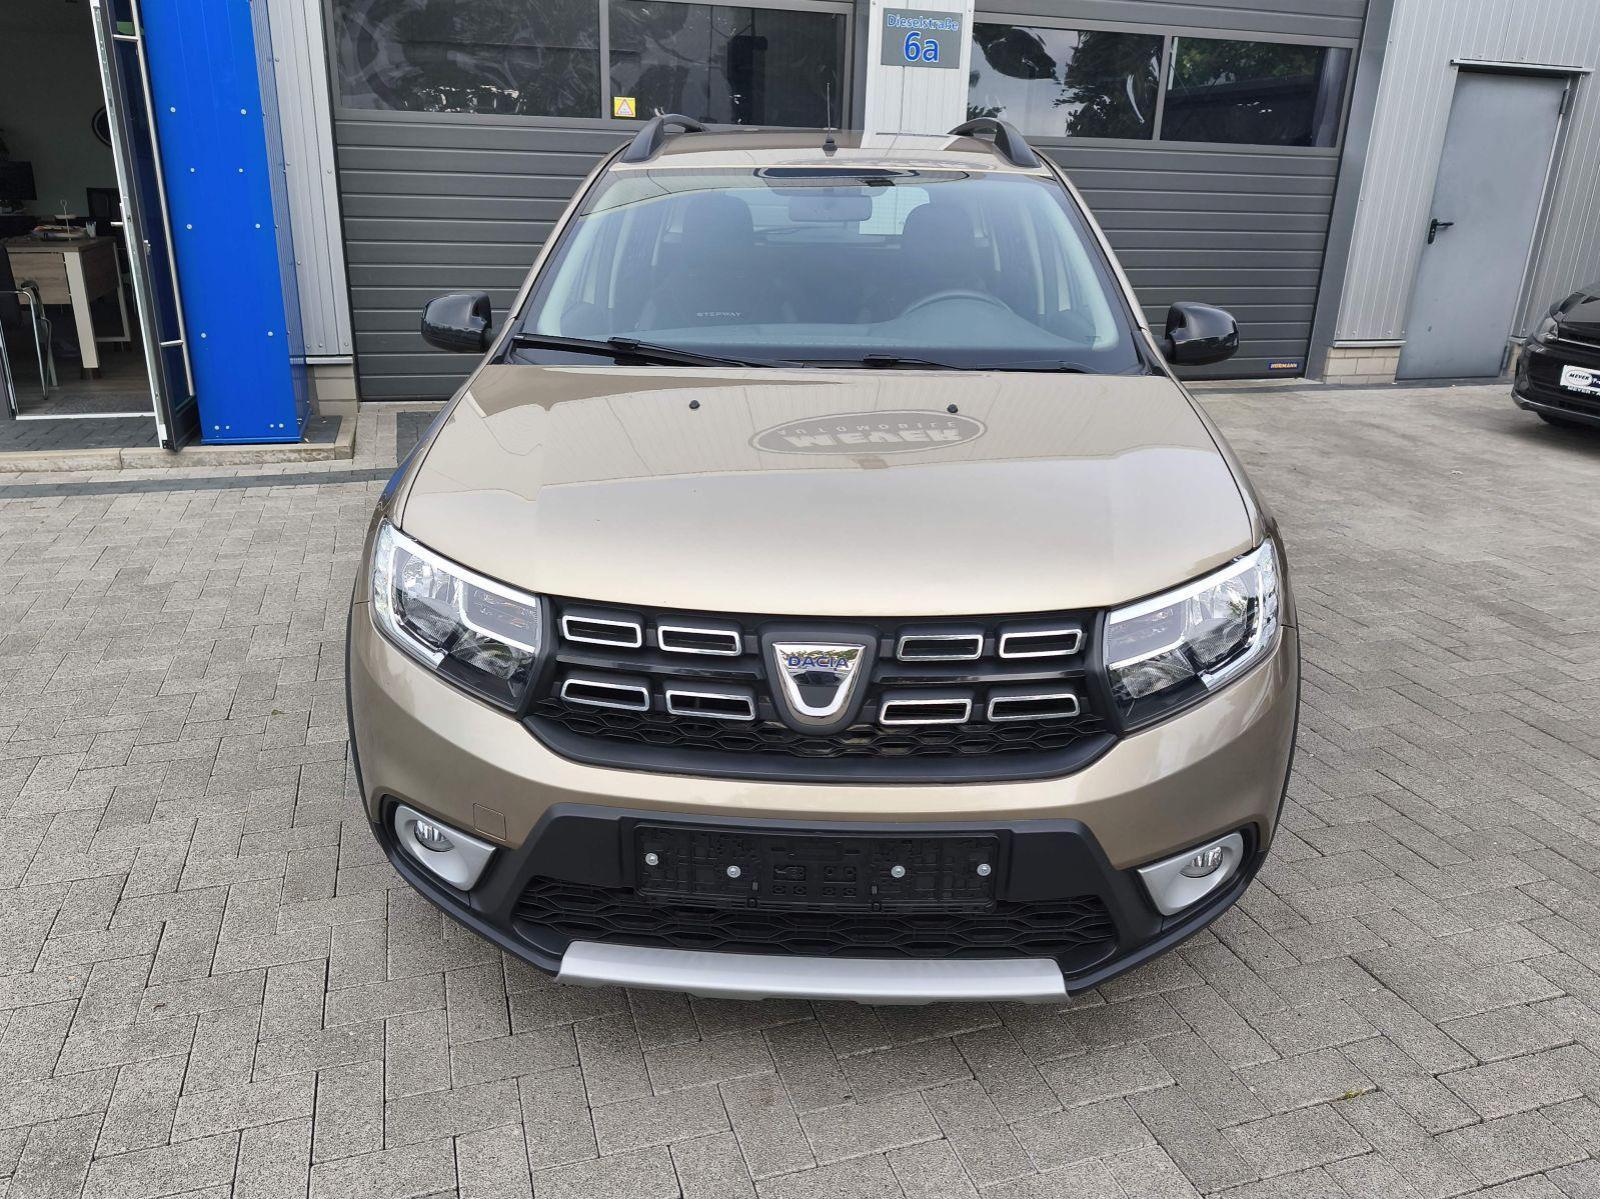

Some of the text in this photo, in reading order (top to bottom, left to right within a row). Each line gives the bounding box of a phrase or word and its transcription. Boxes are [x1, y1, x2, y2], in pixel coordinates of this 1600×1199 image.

[887, 13, 960, 31] Dieselstraße
[903, 31, 939, 63] 6a
[787, 655, 849, 669] DACIA
